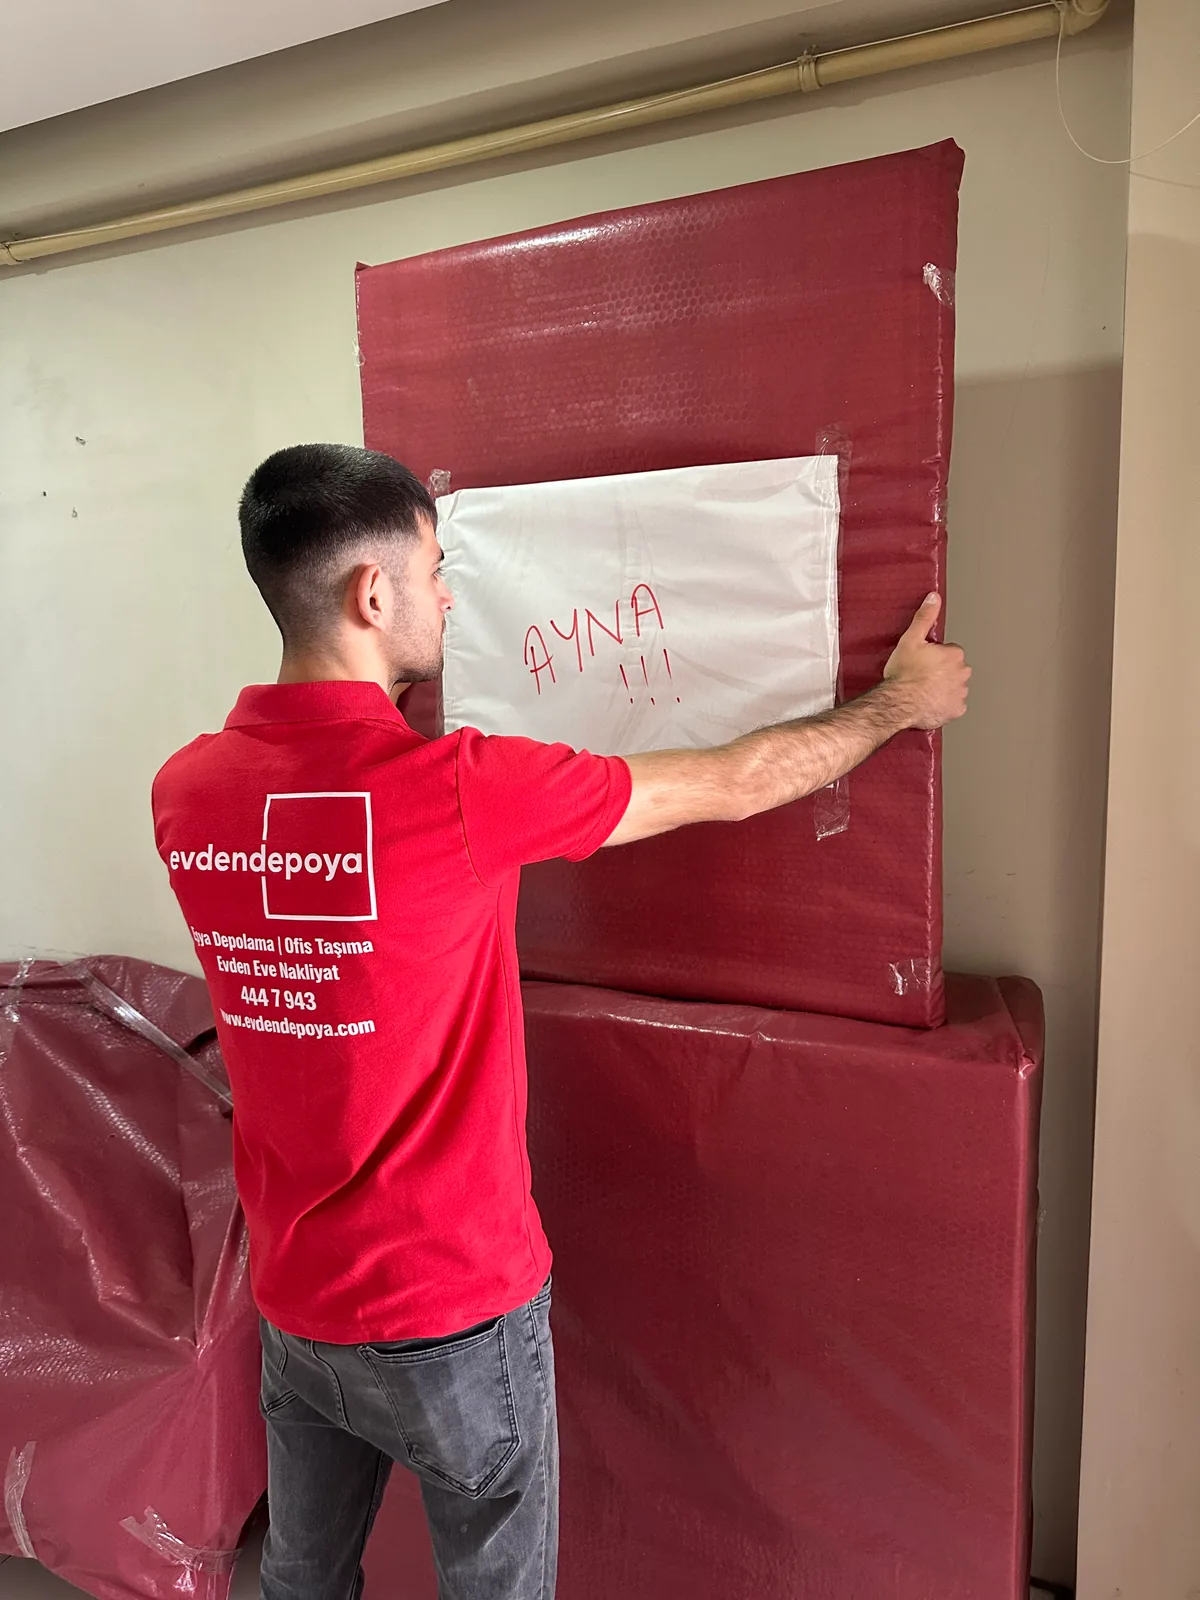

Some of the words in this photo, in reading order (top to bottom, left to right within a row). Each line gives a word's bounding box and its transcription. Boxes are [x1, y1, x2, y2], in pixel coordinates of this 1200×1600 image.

[524, 584, 664, 695] AYNA
[170, 843, 363, 881] evdendepoya
[212, 931, 275, 952] Depolama
[284, 937, 313, 954] Ofis
[315, 938, 374, 958] Taşıma
[217, 956, 251, 975] Evden
[253, 960, 277, 978] Eve
[279, 964, 340, 983] Nakliyat
[240, 985, 269, 1007] 444
[270, 989, 281, 1008] 7
[283, 990, 317, 1011] 943
